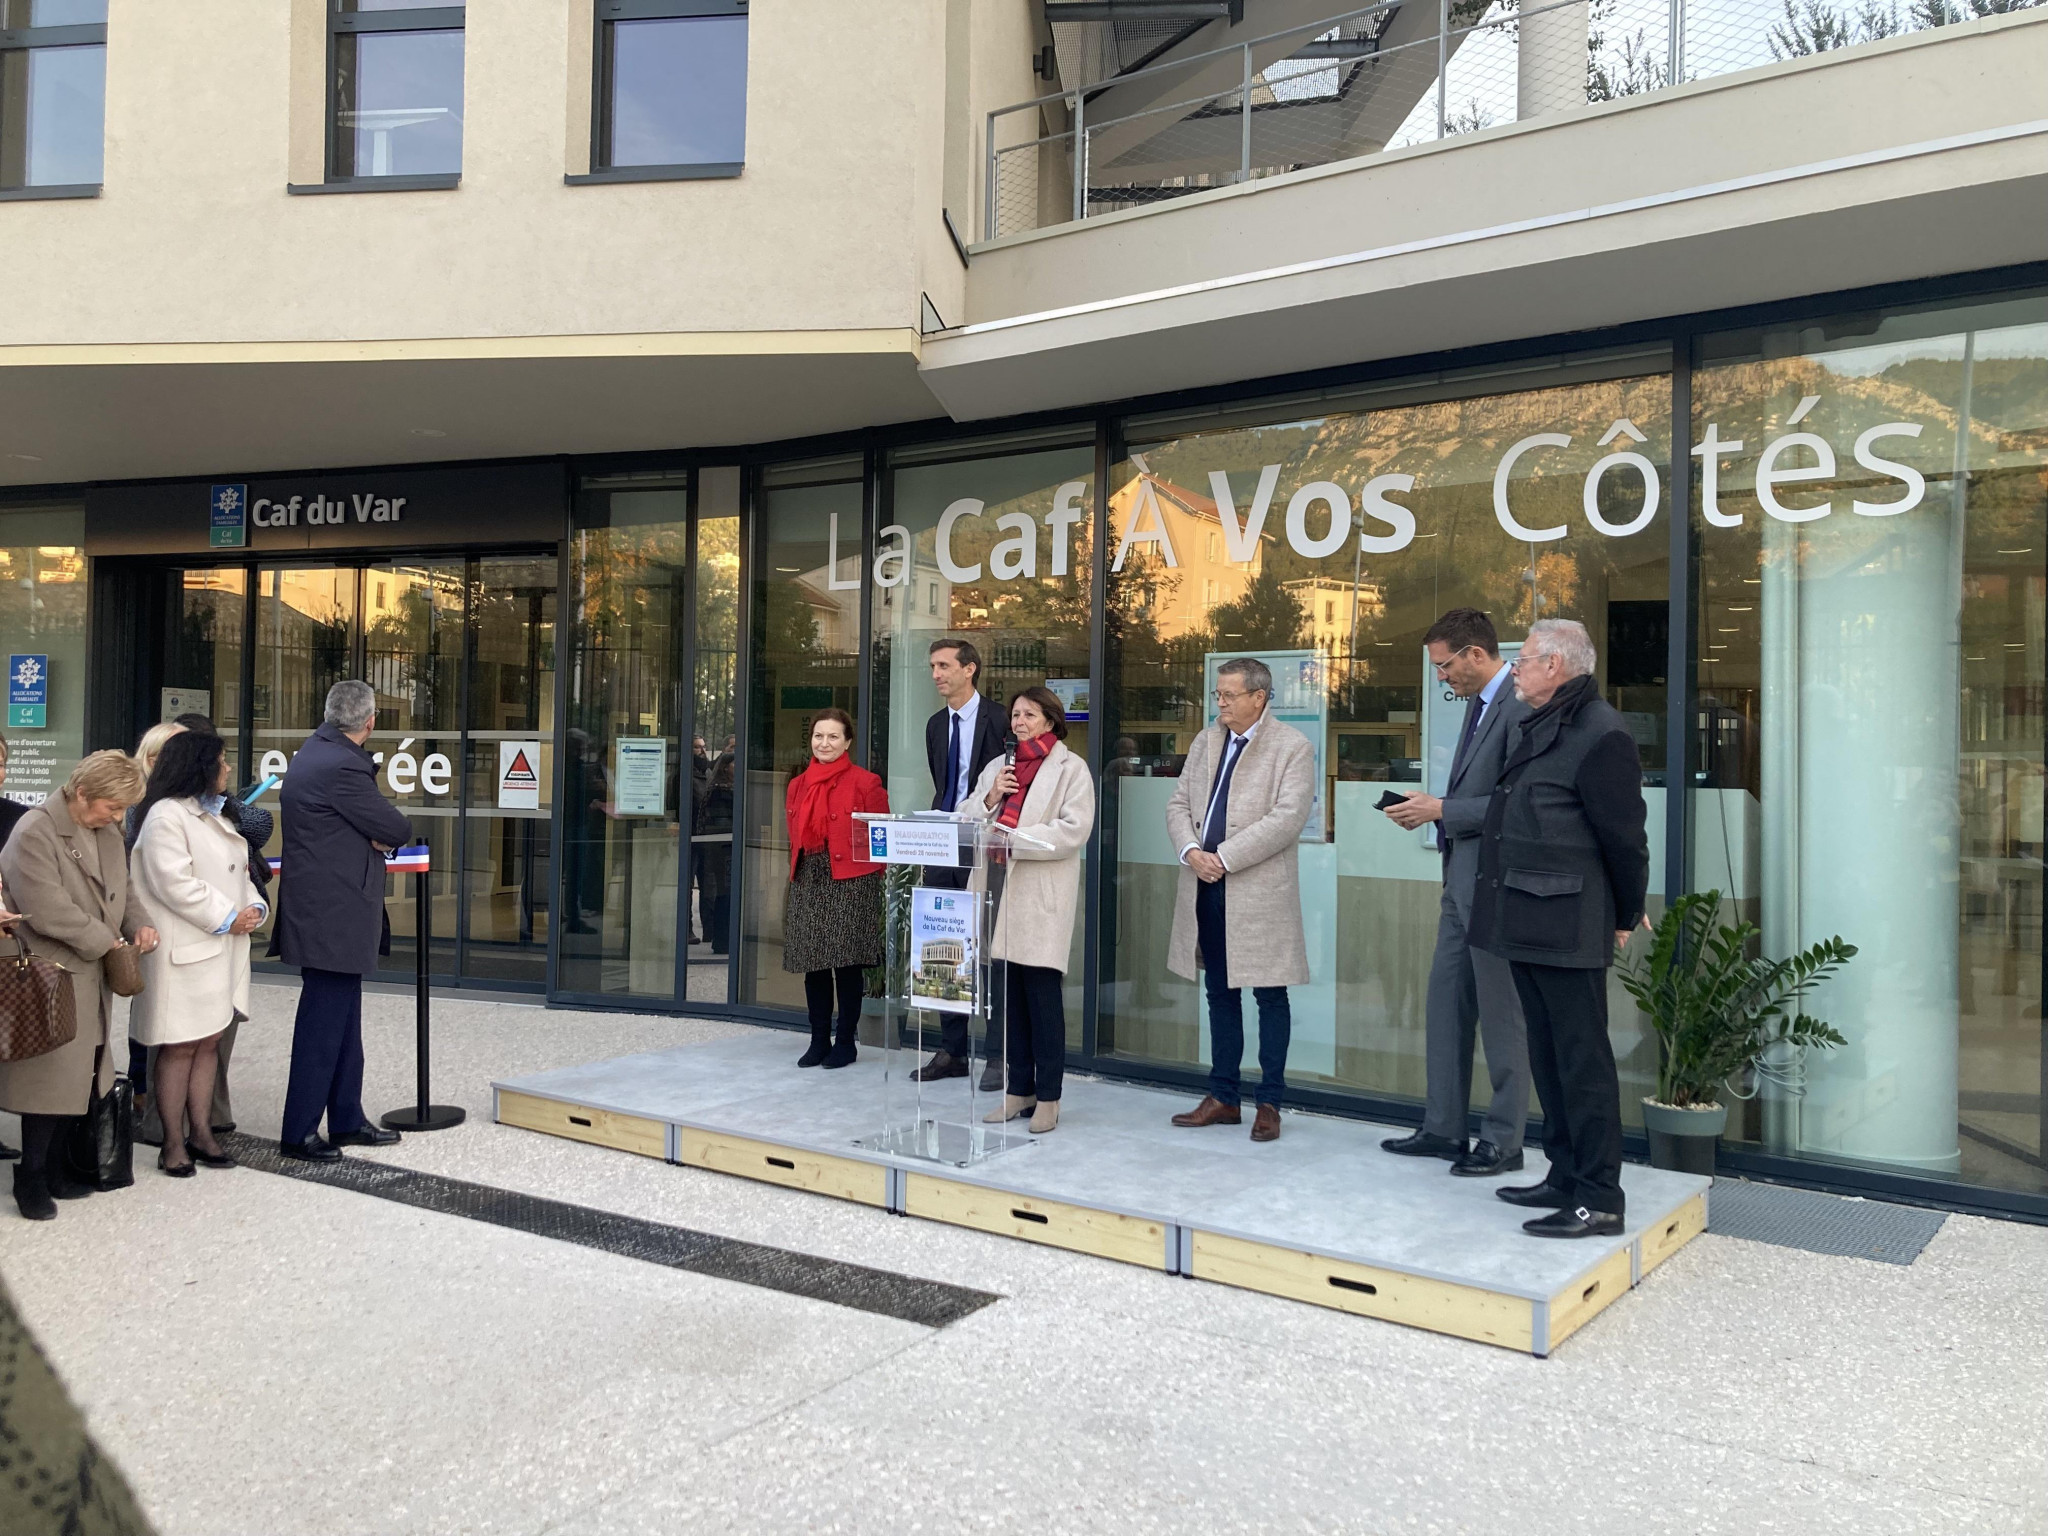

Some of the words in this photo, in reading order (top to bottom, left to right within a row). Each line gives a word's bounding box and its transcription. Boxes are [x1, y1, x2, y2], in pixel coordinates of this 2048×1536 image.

[828, 512, 912, 590] La
[935, 481, 1087, 584] Caf
[1111, 453, 1179, 573] À
[1208, 464, 1417, 564] Vos
[1493, 395, 1926, 542] Côtés
[252, 496, 303, 527] Caf
[306, 494, 345, 525] du
[352, 493, 407, 523] Var
[221, 530, 232, 538] Caf
[21, 708, 33, 717] Caf
[20, 738, 57, 746] d'ouverture
[21, 748, 40, 757] public
[30, 758, 57, 766] vendredi
[10, 767, 26, 775] 8h00
[26, 767, 31, 775] à
[31, 767, 50, 775] 16h00
[14, 777, 52, 786] interruption
[894, 830, 950, 840] INAUGURATION
[896, 848, 918, 856] Vendredi
[925, 850, 950, 858] novembre
[923, 914, 949, 923] Nouveau
[949, 917, 965, 925] siège
[936, 924, 947, 932] Caf
[947, 925, 955, 933] du
[956, 926, 966, 934] Var
